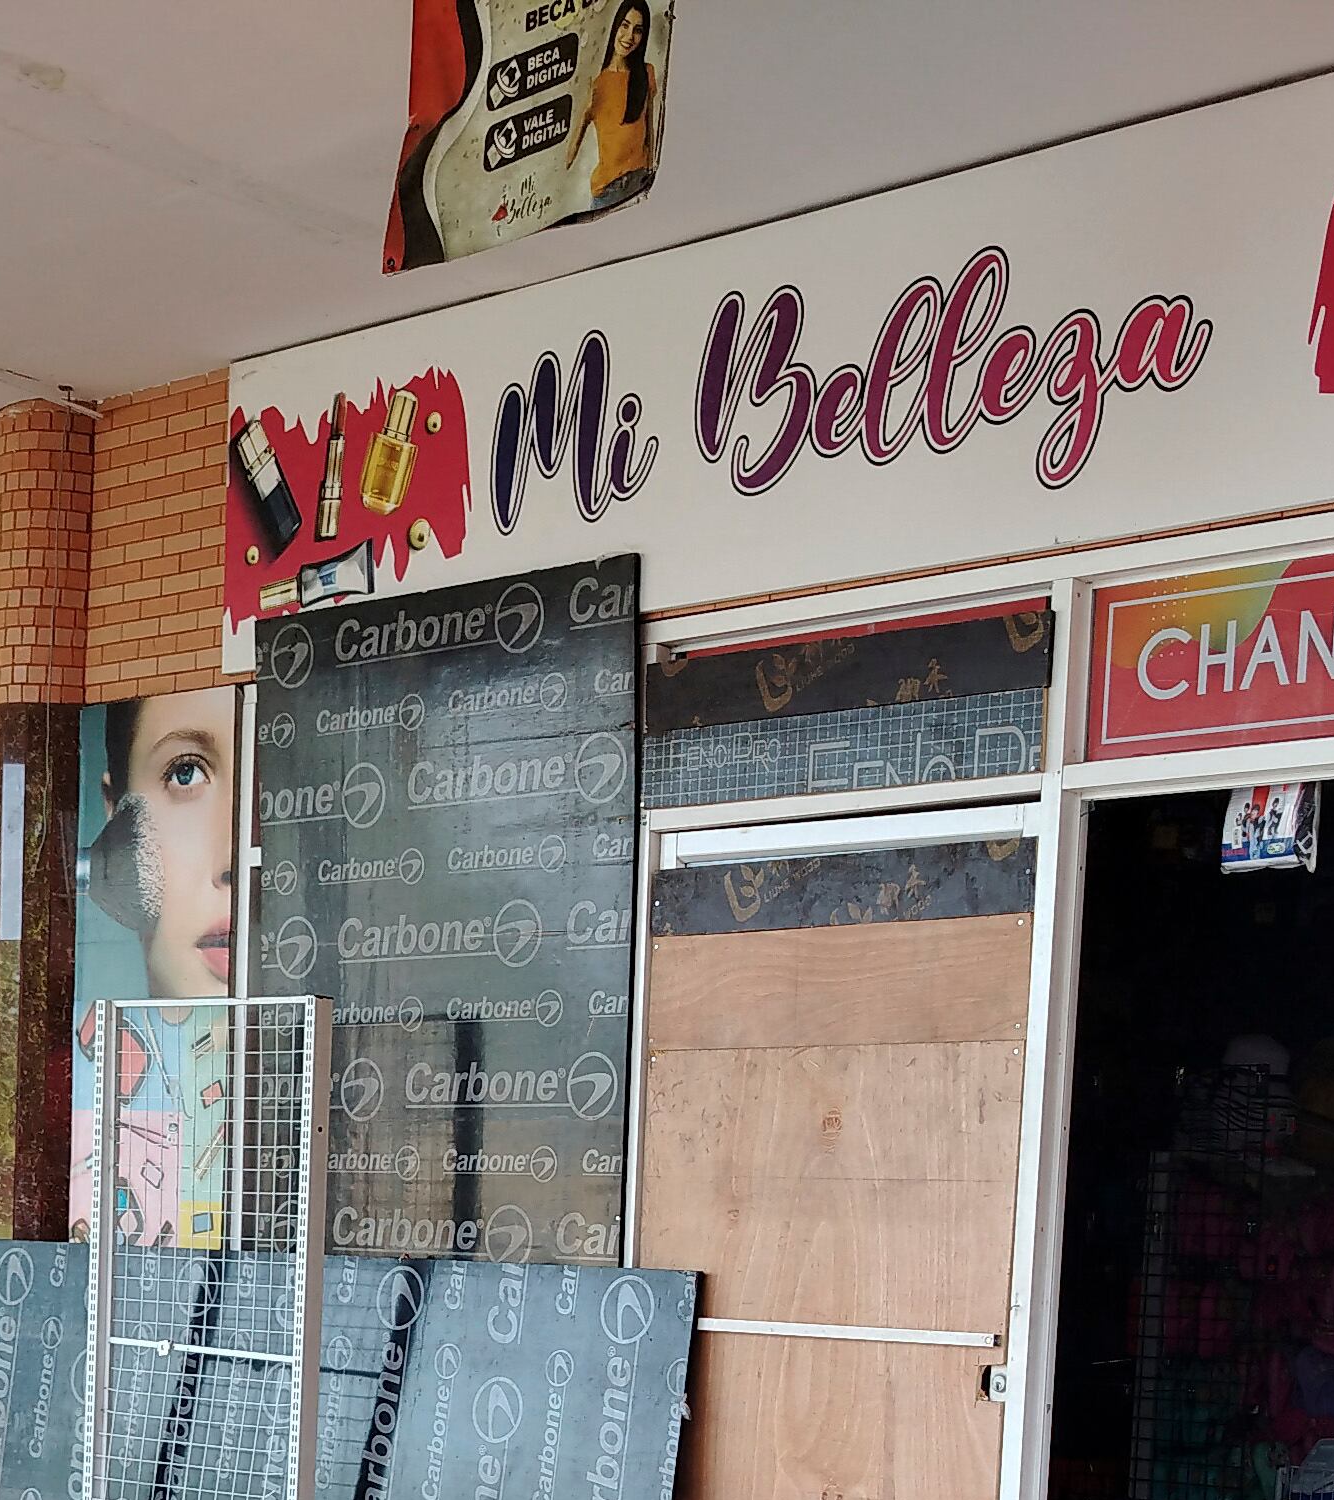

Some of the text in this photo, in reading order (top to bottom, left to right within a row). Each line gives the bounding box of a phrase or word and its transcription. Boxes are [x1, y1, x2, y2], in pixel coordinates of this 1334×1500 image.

[525, 0, 575, 32] BECA
[526, 59, 574, 90] DIGITAL
[527, 46, 560, 72] BECA
[521, 123, 568, 150] DIGITAL
[523, 109, 554, 132] VALE
[520, 176, 535, 197] Mi
[507, 194, 553, 225] Belleza
[490, 244, 1213, 535] Mi Belleza
[334, 608, 485, 661] Carbone
[316, 702, 397, 733] Carbone
[448, 683, 536, 712] Carbone
[407, 752, 565, 804] Carbone
[318, 854, 394, 882] Carbone
[447, 840, 532, 871] Carbone
[337, 914, 484, 959] Carbone
[332, 1001, 395, 1024] arbone
[446, 996, 531, 1021] Carbone
[405, 1061, 559, 1103] Carbone
[328, 1147, 392, 1171] arbone
[442, 1147, 527, 1173] Carbone
[333, 1206, 477, 1250] Carbone
[444, 1261, 466, 1310] Car
[555, 1265, 577, 1315] Car
[29, 1353, 54, 1458] Carbone
[315, 1376, 341, 1490] Carbone
